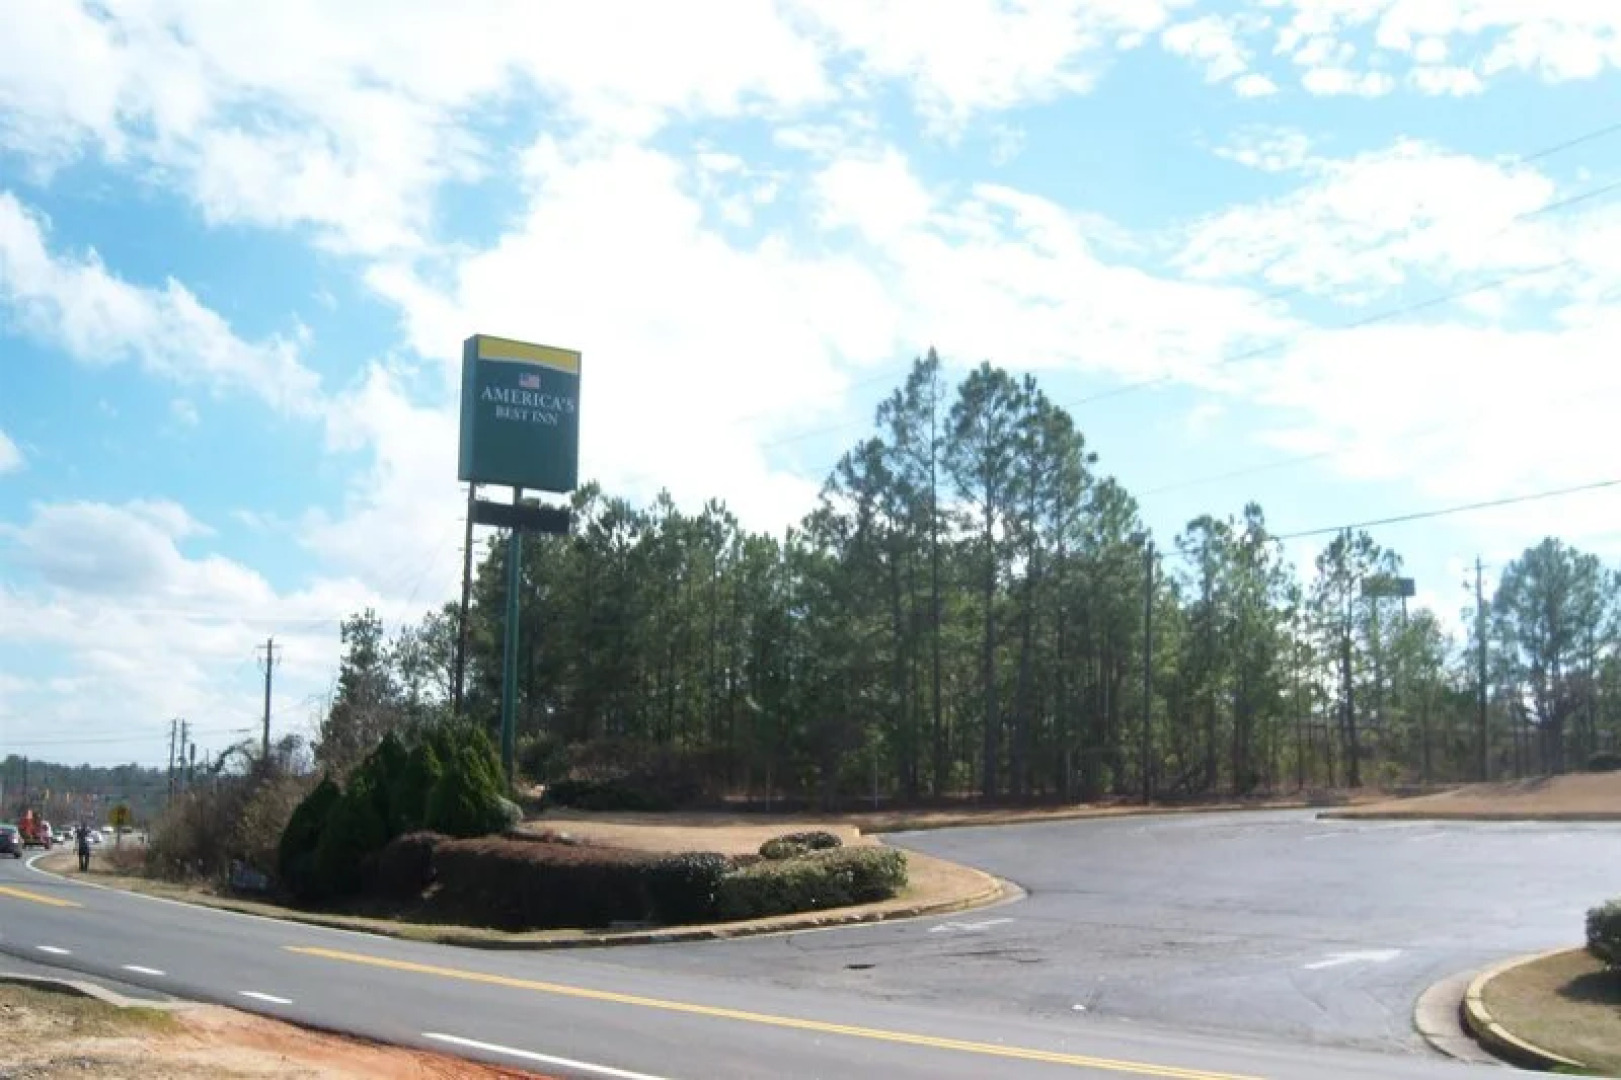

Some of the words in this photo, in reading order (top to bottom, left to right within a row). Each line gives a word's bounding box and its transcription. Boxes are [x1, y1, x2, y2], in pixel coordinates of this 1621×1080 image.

[481, 386, 575, 414] AMERICA'S
[495, 405, 529, 421] BEST
[532, 410, 559, 426] INN
